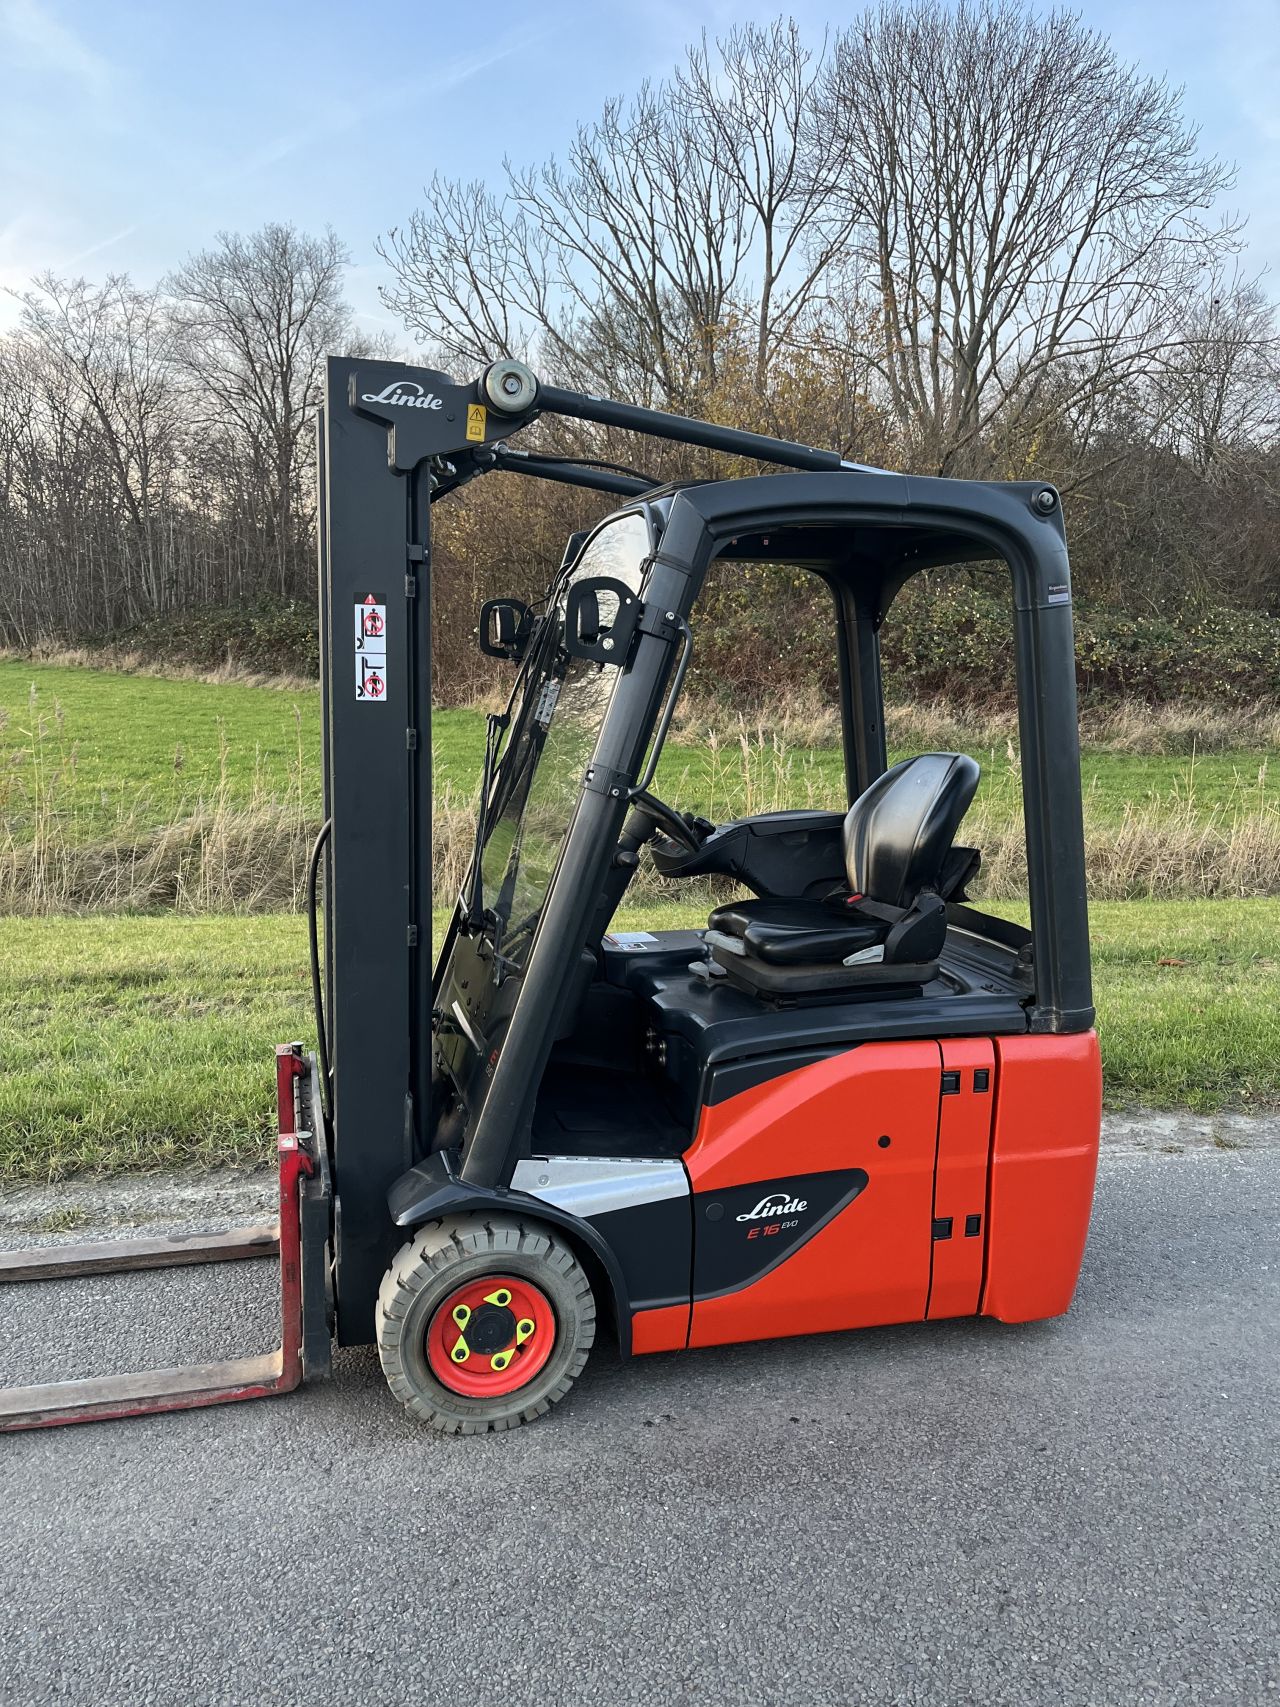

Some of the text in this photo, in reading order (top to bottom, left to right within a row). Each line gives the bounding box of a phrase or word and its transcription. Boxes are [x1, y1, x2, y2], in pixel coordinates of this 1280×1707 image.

[361, 381, 443, 410] Linde
[735, 1193, 808, 1222] Linde
[746, 1227, 761, 1239] E
